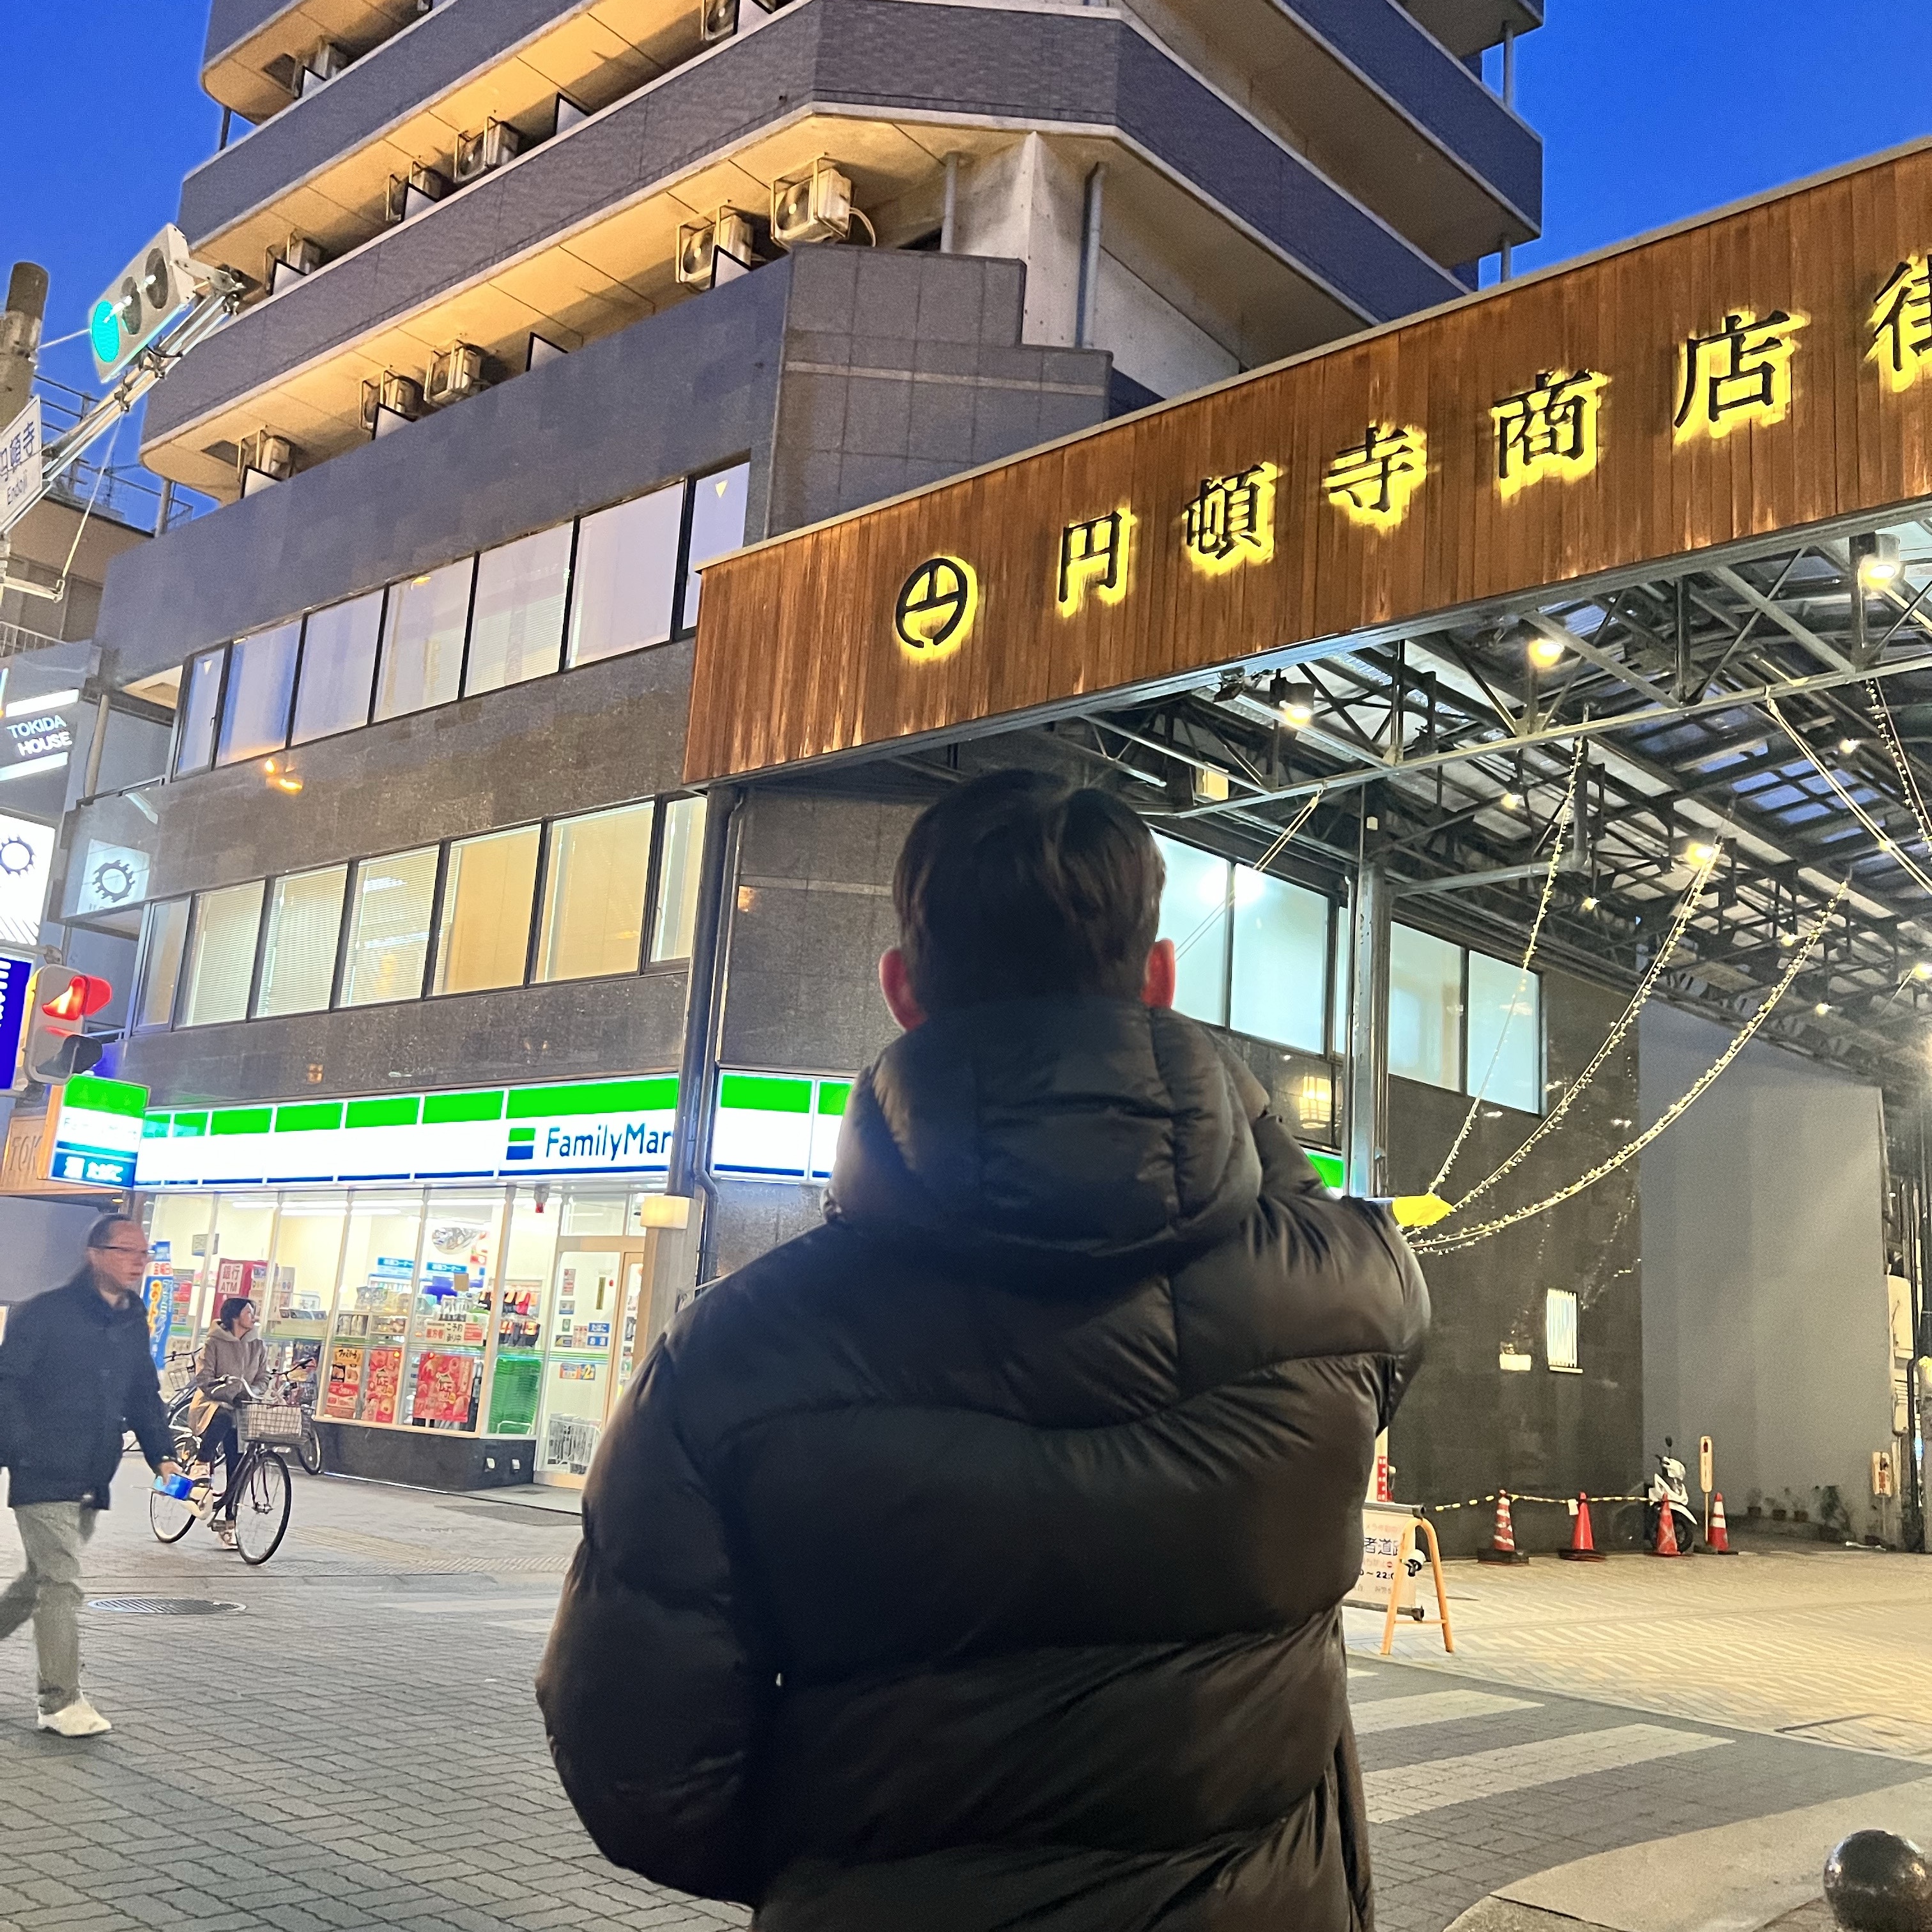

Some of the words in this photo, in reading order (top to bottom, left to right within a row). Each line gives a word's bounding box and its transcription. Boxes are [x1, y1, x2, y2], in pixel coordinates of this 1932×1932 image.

[6, 715, 66, 738] TOKIDA
[17, 730, 73, 756] HOUSE
[546, 1123, 673, 1161] FamilyMar
[223, 1265, 240, 1280] 銀行
[220, 1282, 238, 1292] ATM
